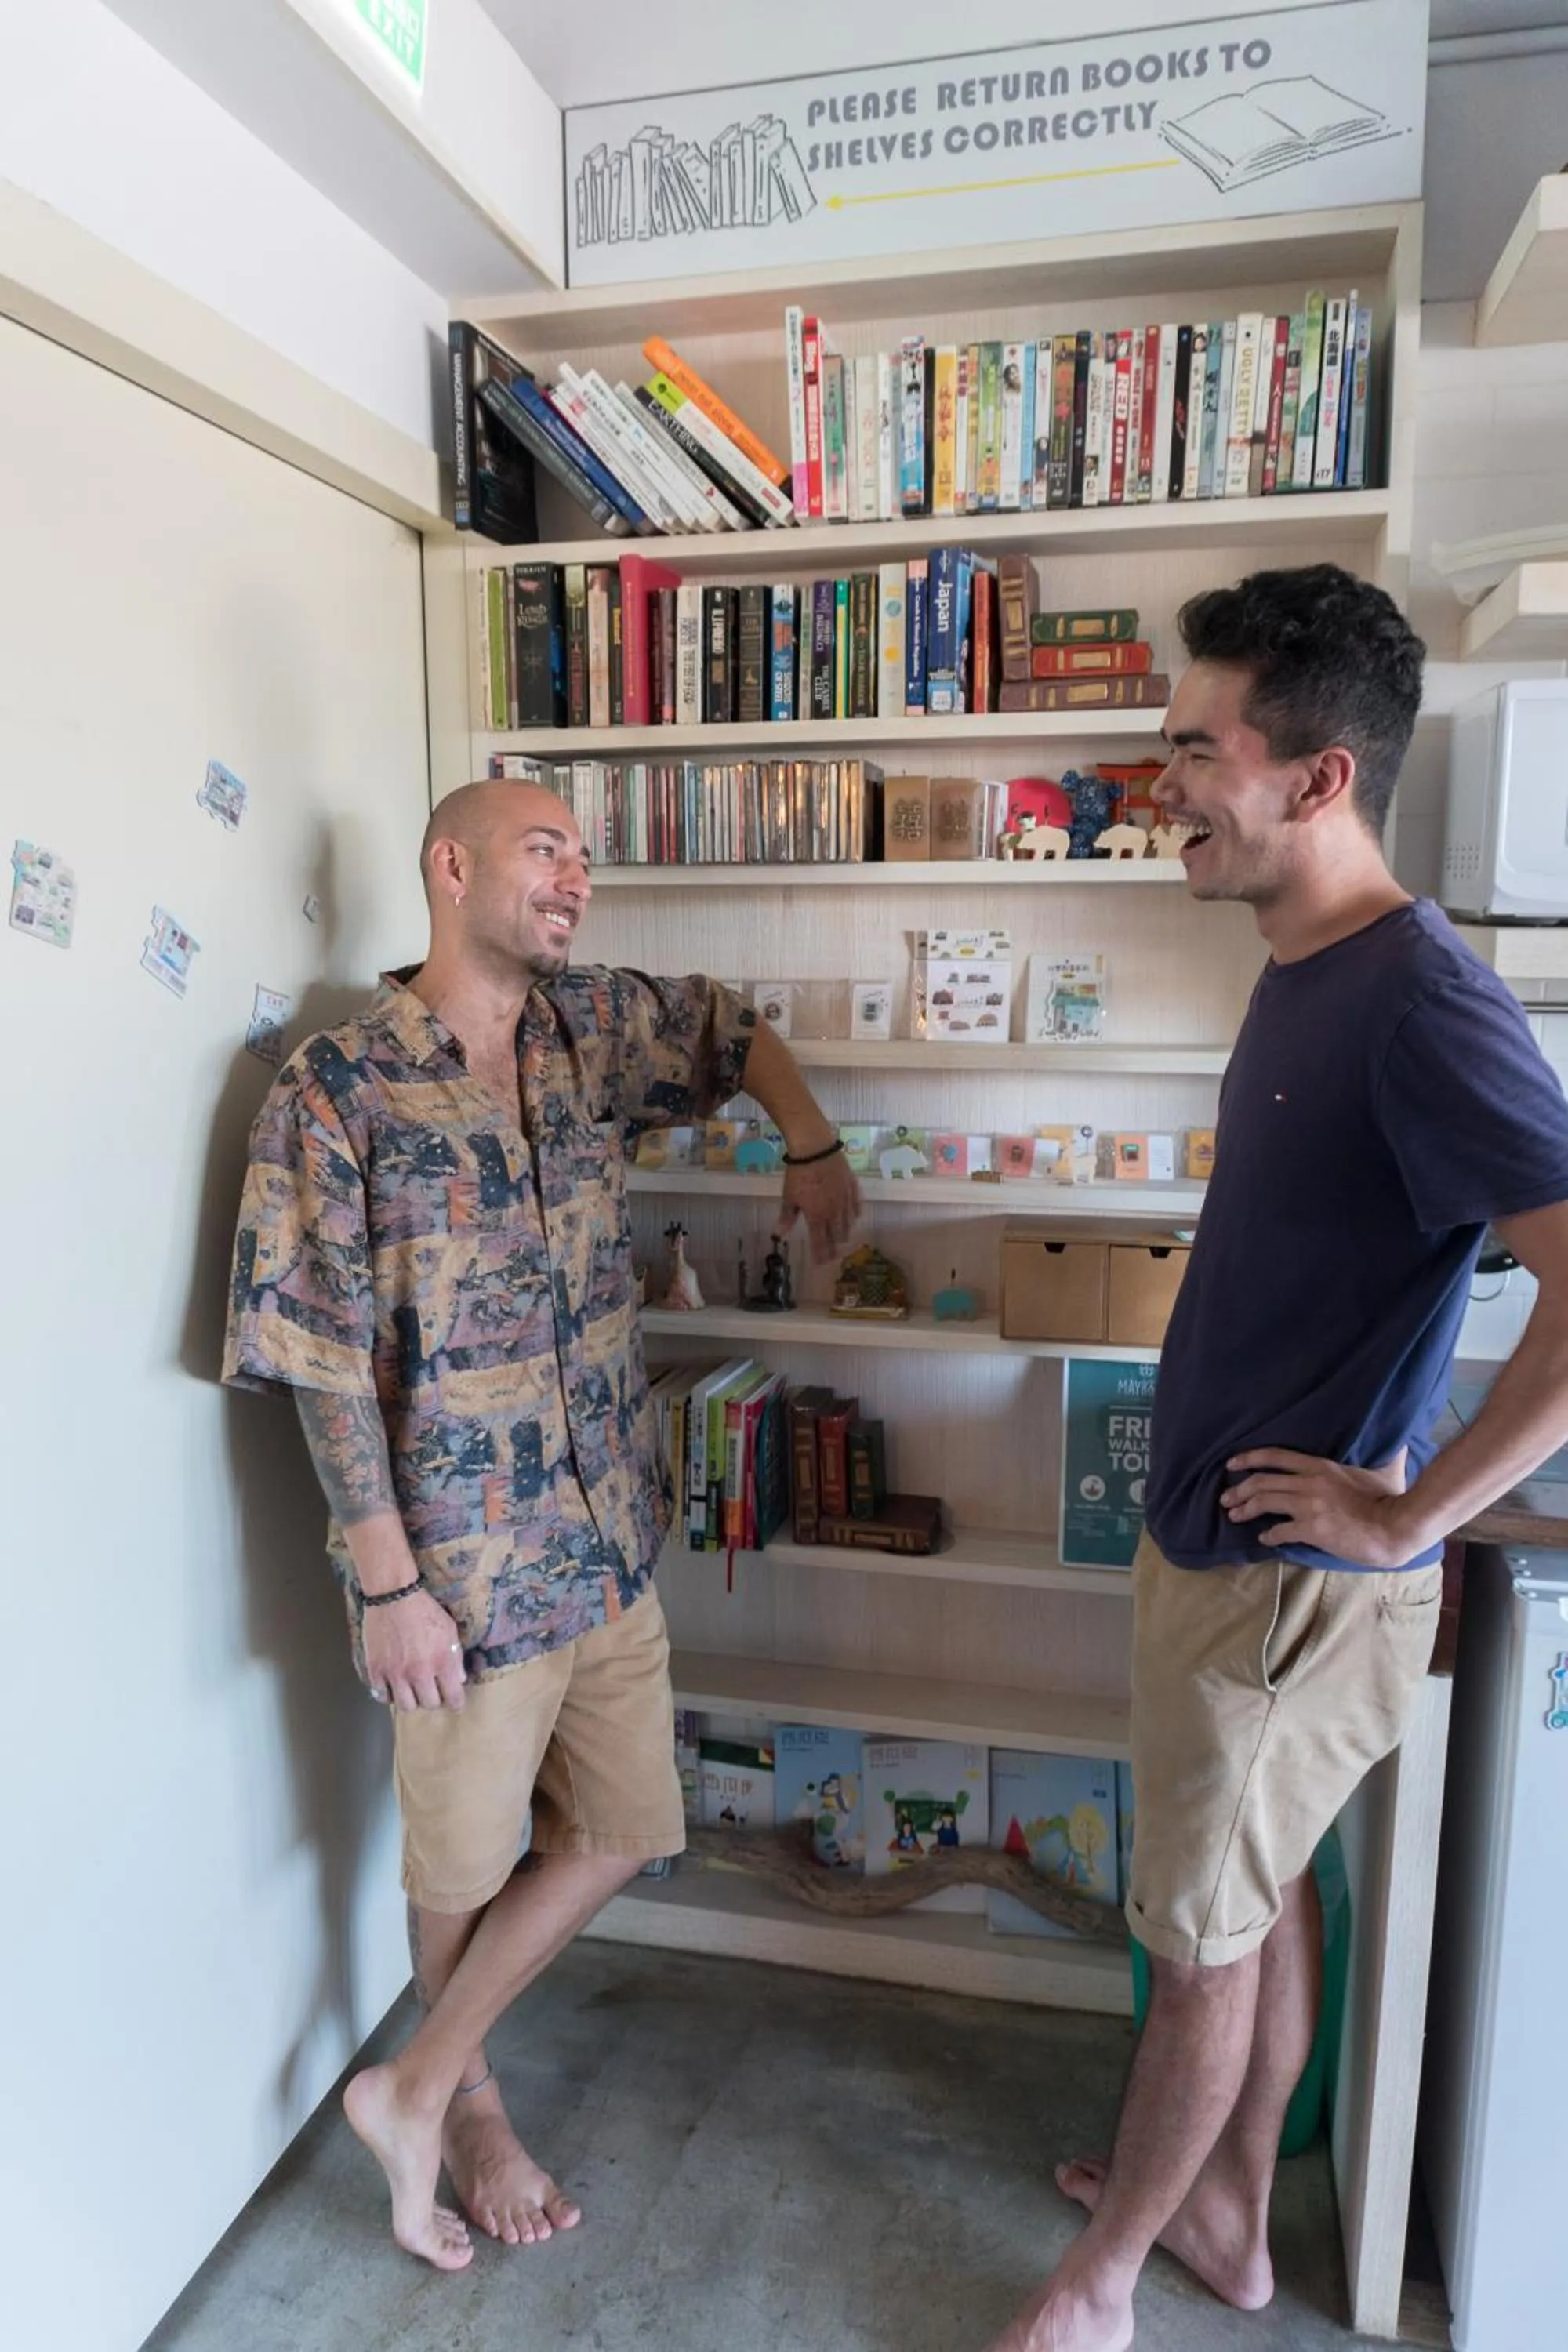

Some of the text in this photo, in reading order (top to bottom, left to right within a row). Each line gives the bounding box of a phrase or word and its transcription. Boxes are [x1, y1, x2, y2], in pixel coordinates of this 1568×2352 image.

[807, 38, 1272, 127] PLEASE RETURN BOOKS TO
[807, 100, 1159, 172] SHELVES CORRECTLY
[455, 353, 467, 485] MANAGEMENT ACCOUNTING
[648, 398, 699, 453] EARTHING
[1116, 373, 1130, 419] RED
[1236, 348, 1254, 436] UGLY BETTY
[937, 579, 953, 633] Japan
